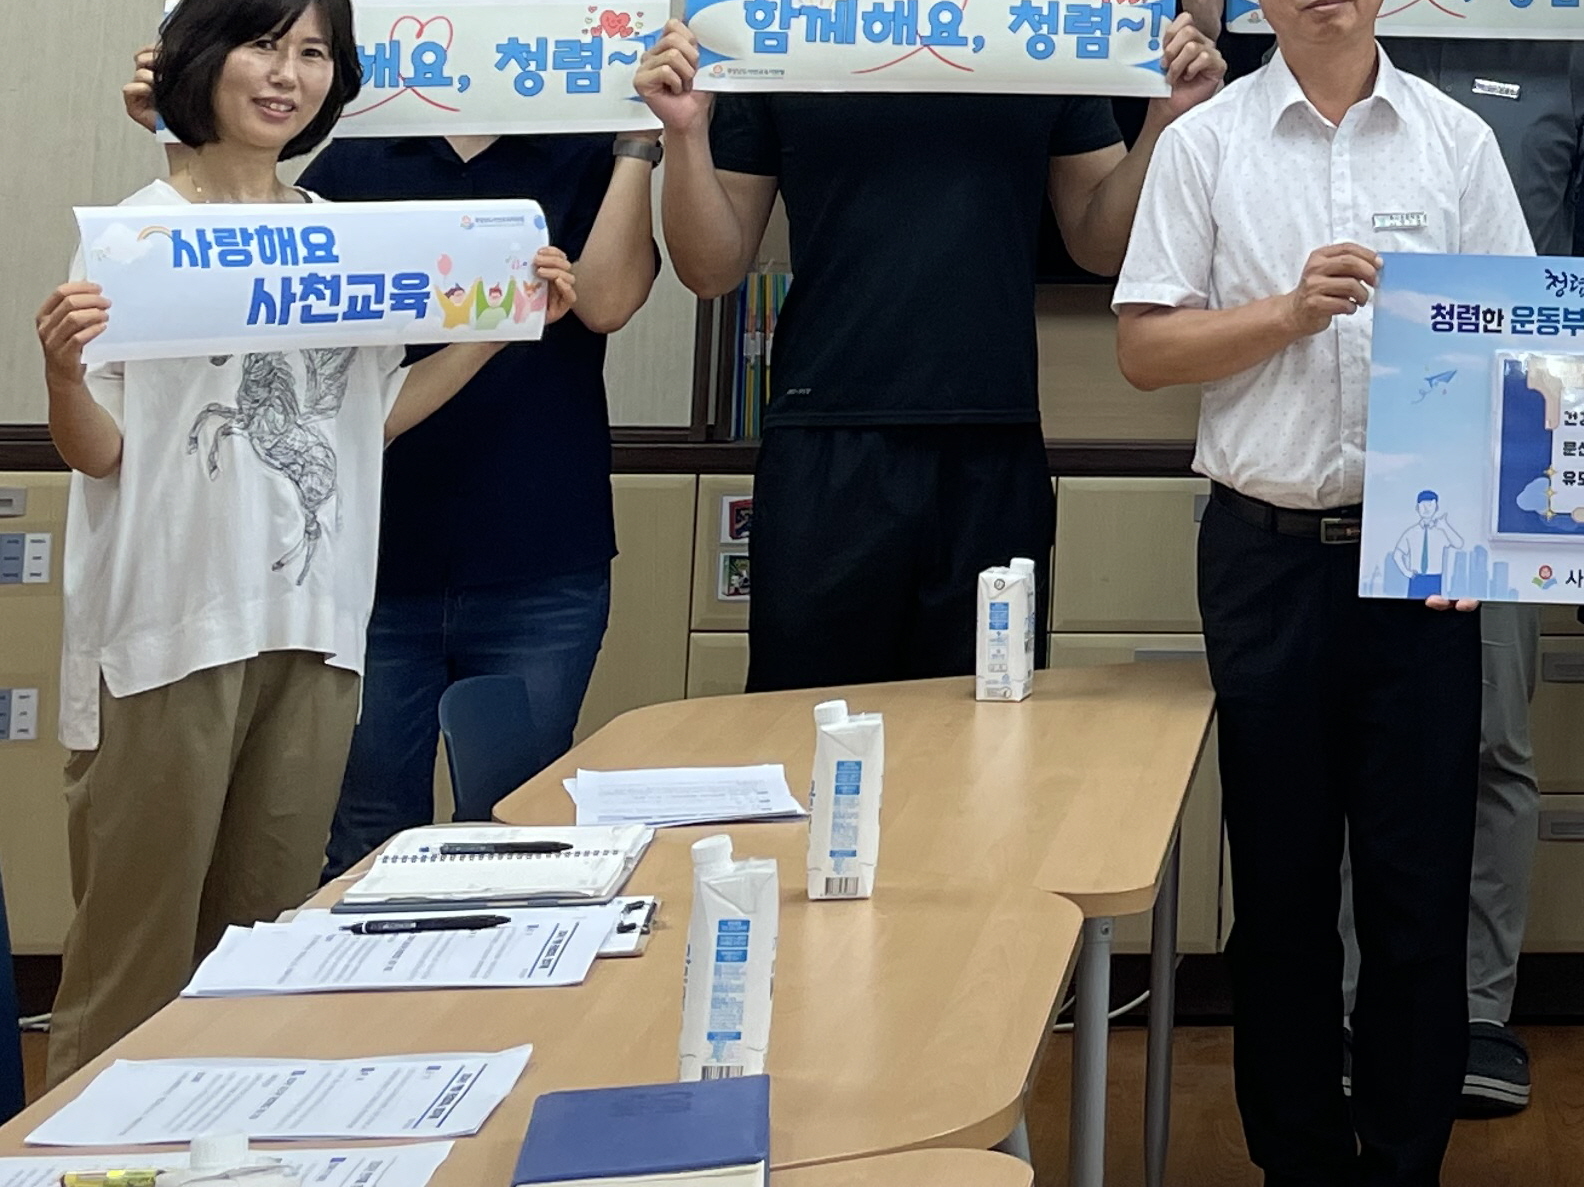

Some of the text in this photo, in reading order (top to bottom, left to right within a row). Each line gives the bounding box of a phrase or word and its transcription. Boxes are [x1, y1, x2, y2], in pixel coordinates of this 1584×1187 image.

[356, 37, 656, 97] 해요, 청렴~
[170, 225, 340, 269] 사랑해요
[246, 272, 431, 326] 사천교육
[1430, 302, 1505, 335] 청렴한
